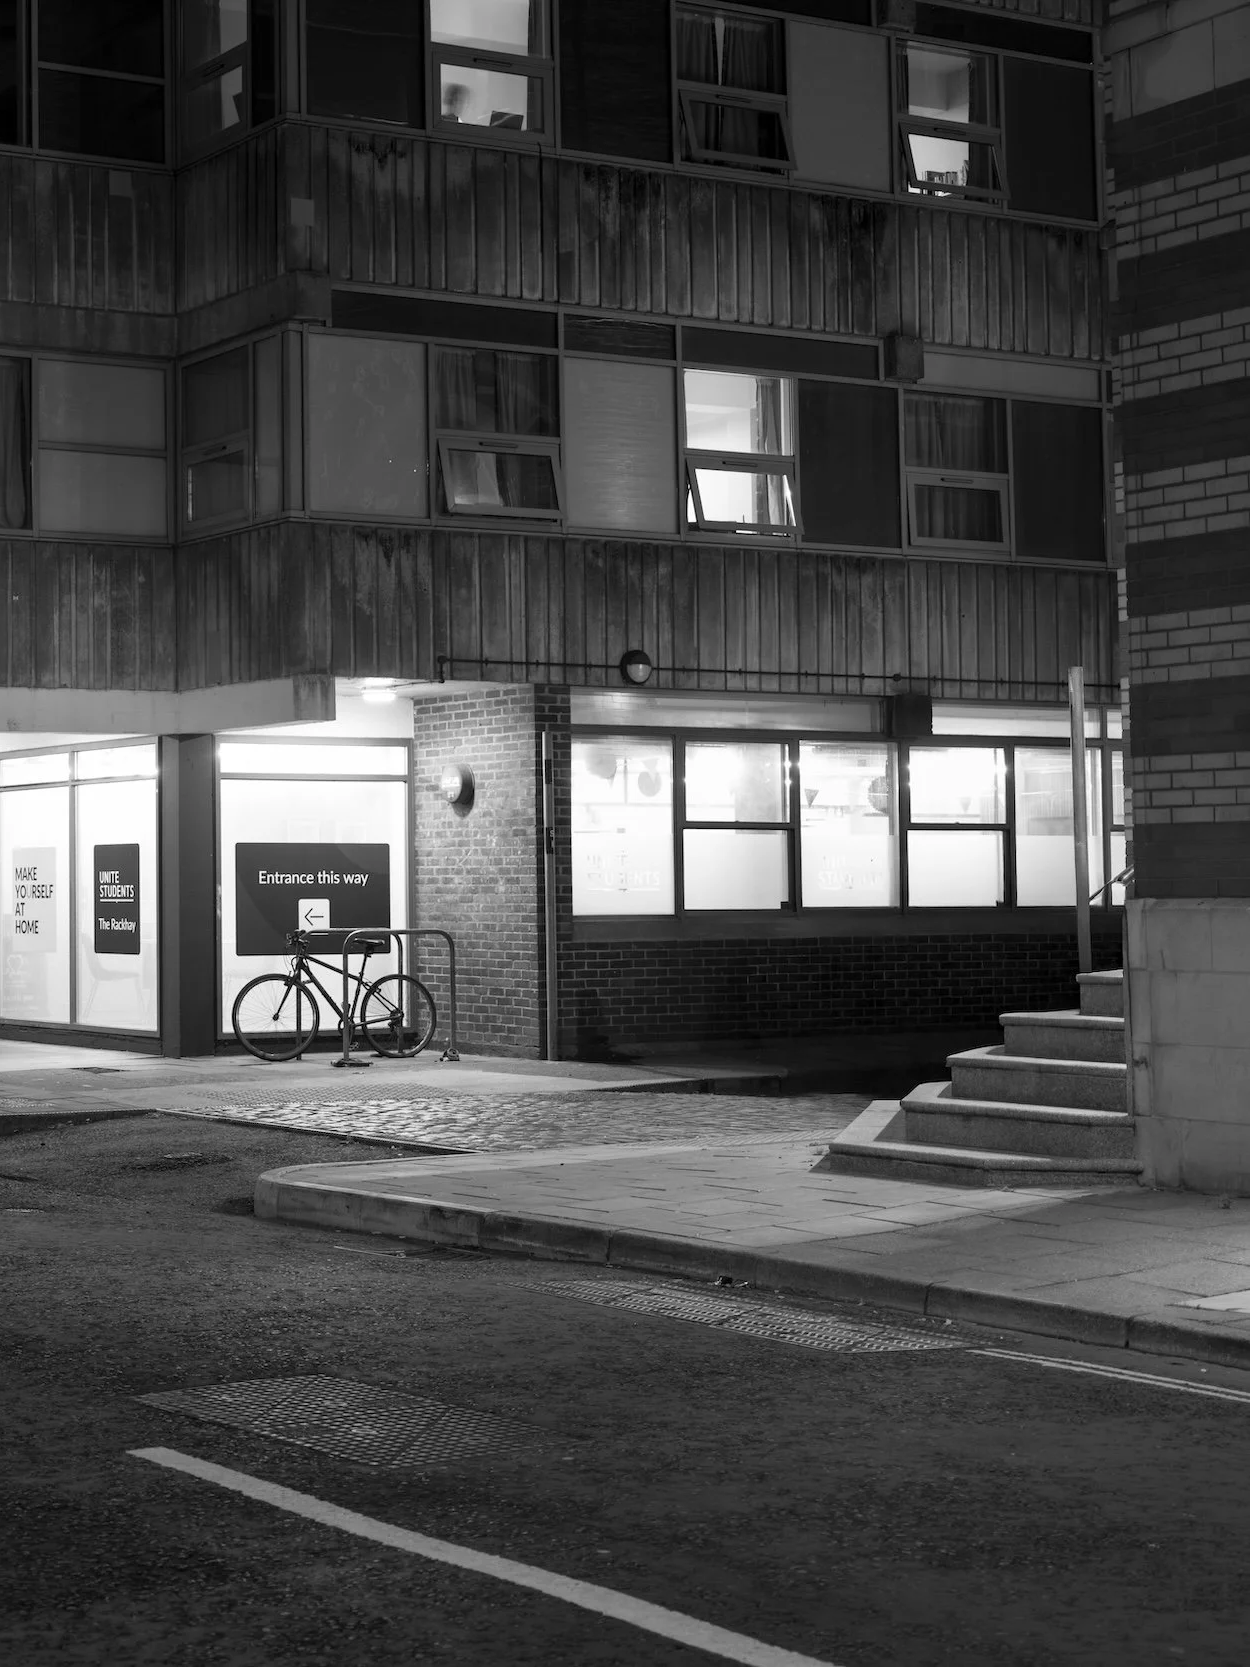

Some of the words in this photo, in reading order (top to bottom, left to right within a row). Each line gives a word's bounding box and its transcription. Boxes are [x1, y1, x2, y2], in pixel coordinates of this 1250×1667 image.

[15, 867, 37, 881] MAKE
[99, 871, 119, 884] UNITE
[259, 870, 314, 884] Entrance
[317, 870, 340, 884] this
[343, 872, 369, 886] way
[15, 885, 53, 899] YOURSELF
[99, 885, 134, 898] STUDENTS
[15, 903, 25, 917] AT
[15, 920, 39, 934] HOME
[98, 918, 110, 930] The
[111, 918, 136, 933] Rackhay
